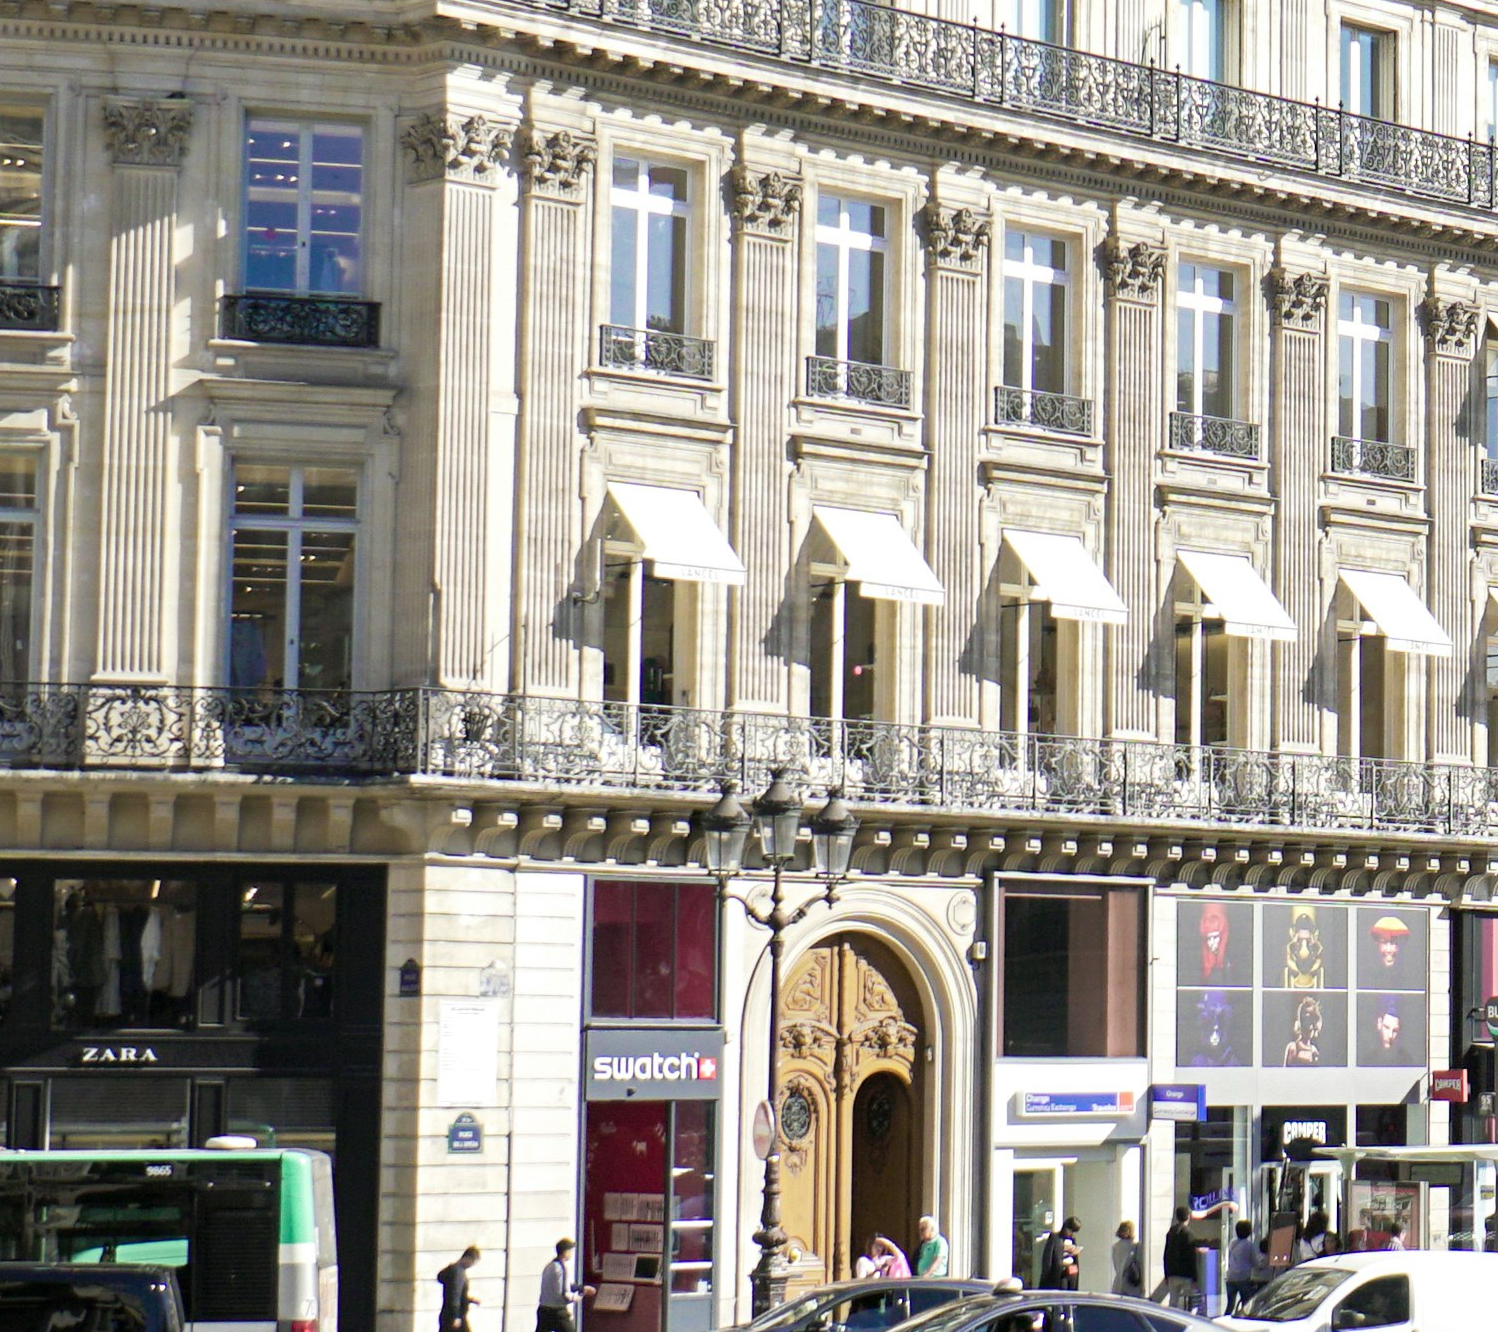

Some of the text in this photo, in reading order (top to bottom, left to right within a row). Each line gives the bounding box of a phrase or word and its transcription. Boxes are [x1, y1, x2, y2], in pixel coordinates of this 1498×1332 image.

[82, 1047, 158, 1062] ZARA
[593, 1052, 700, 1080] swatch
[1283, 1121, 1327, 1144] CAMPER
